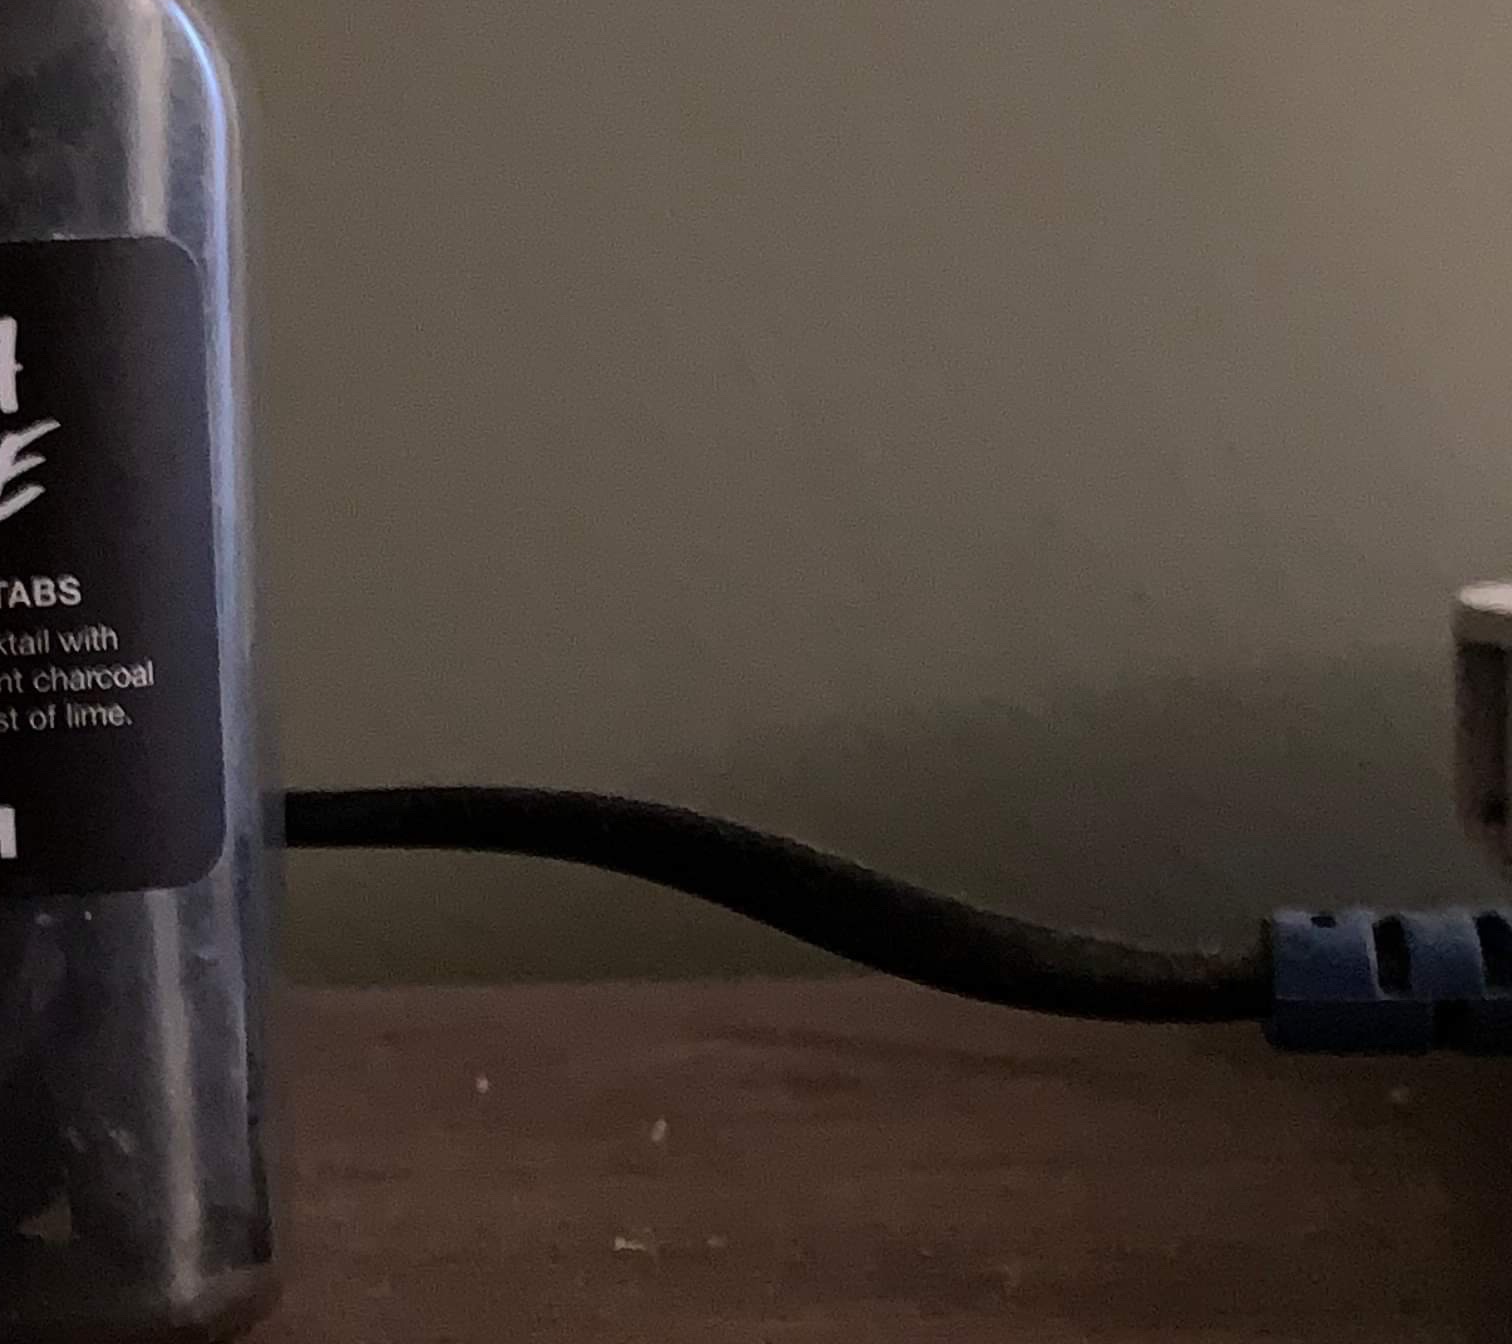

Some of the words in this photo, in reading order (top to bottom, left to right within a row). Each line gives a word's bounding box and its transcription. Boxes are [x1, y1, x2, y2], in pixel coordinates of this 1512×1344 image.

[58, 623, 119, 652] with
[33, 658, 155, 692] charcoal
[29, 704, 57, 730] of
[66, 700, 132, 728] lime.
